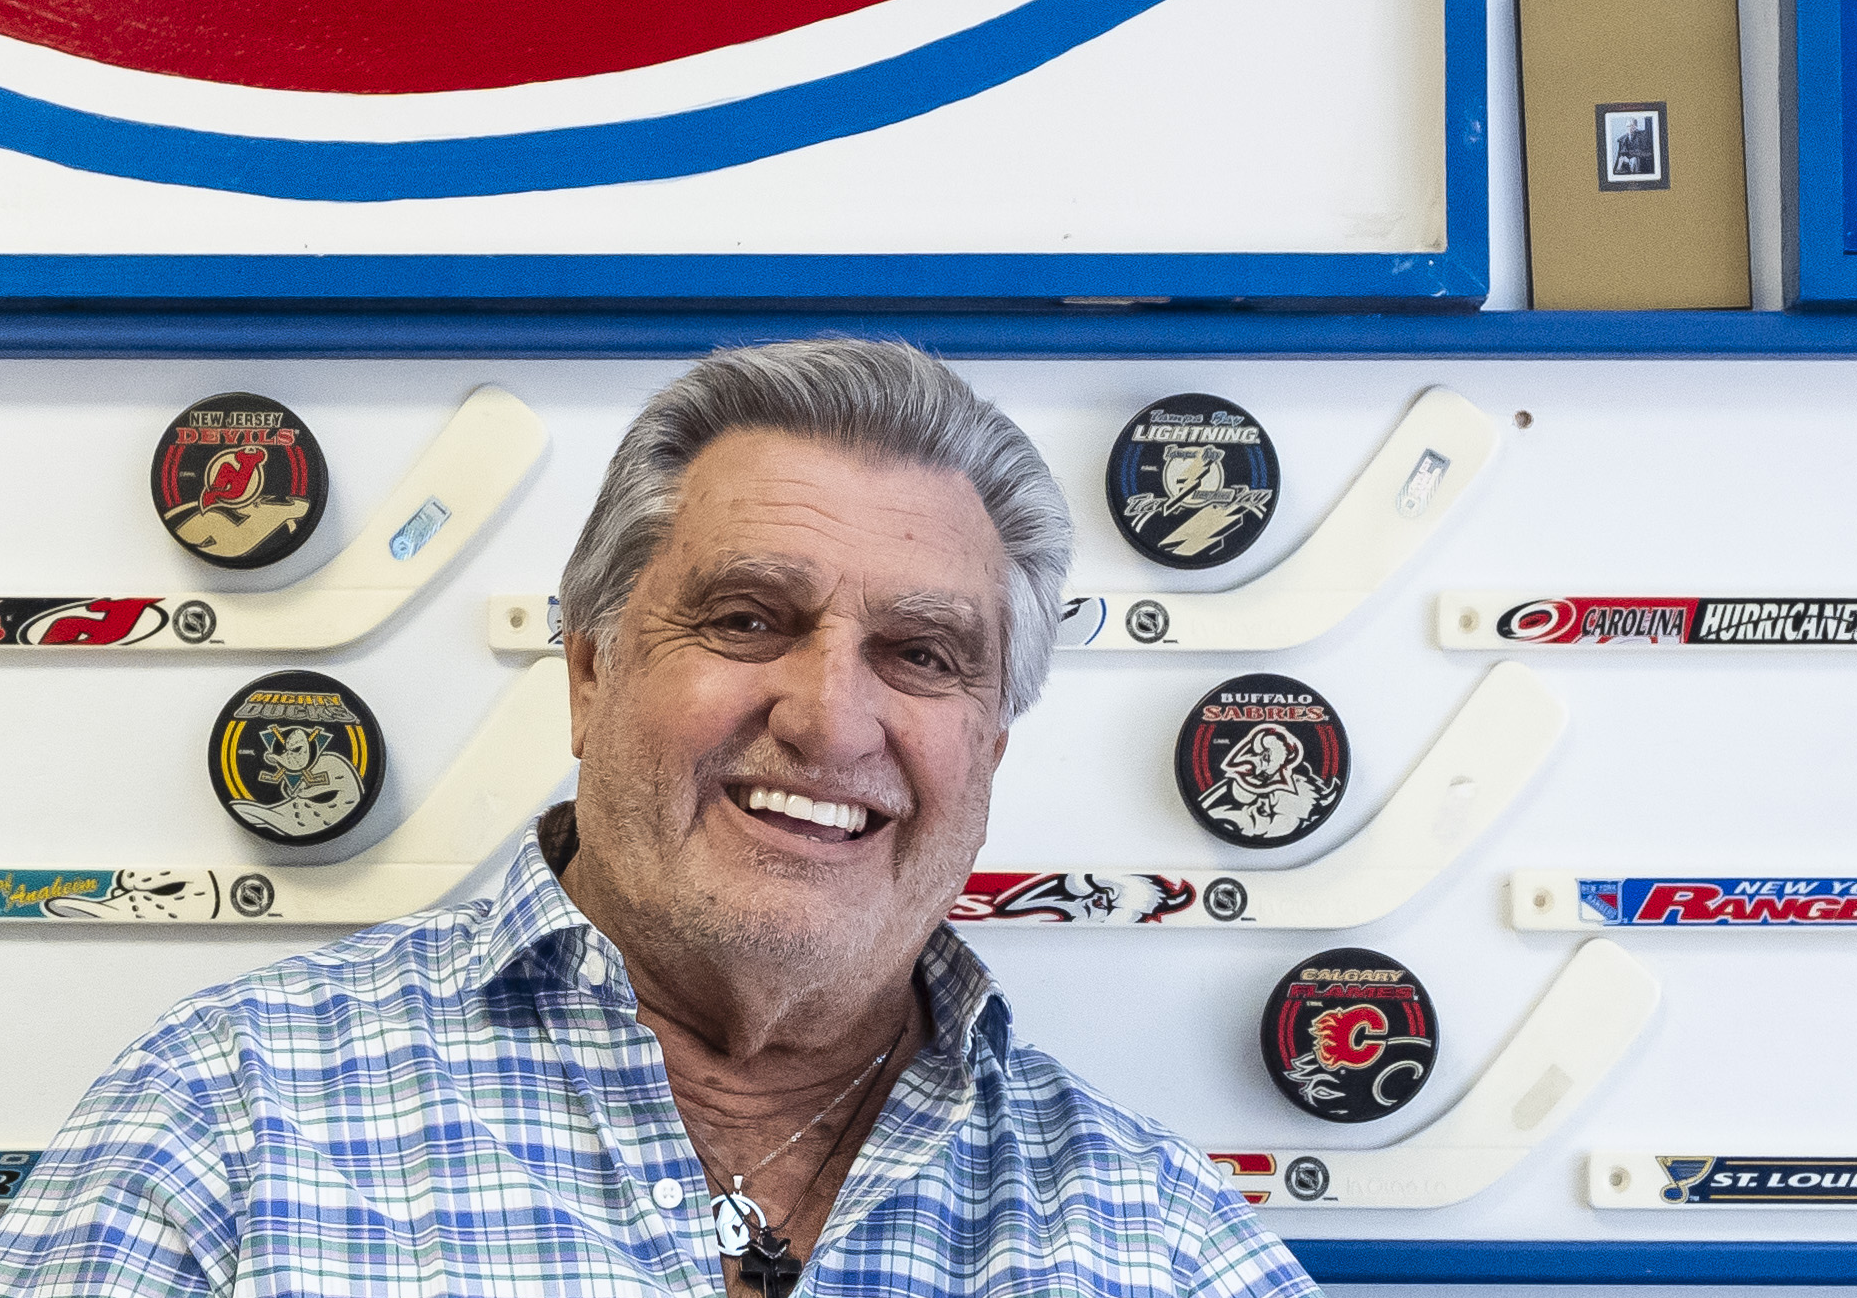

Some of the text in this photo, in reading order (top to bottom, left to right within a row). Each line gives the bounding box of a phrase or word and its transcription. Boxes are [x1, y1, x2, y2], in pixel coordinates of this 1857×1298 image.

[190, 412, 284, 428] NEW JERSEY
[176, 428, 296, 447] DEVILS
[1132, 425, 1258, 443] LIGHTNING
[1581, 606, 1685, 637] CAROLINA
[246, 691, 343, 705] MIGHTY
[1221, 693, 1313, 705] BUFFALO
[234, 703, 357, 723] DUCKS
[1202, 705, 1325, 722] SABRES
[11, 876, 100, 908] Anaheim
[1734, 880, 1809, 895] NEW
[1300, 969, 1405, 983] CALGARY
[1287, 984, 1415, 1000] FLAMES
[1709, 1172, 1762, 1189] ST.
